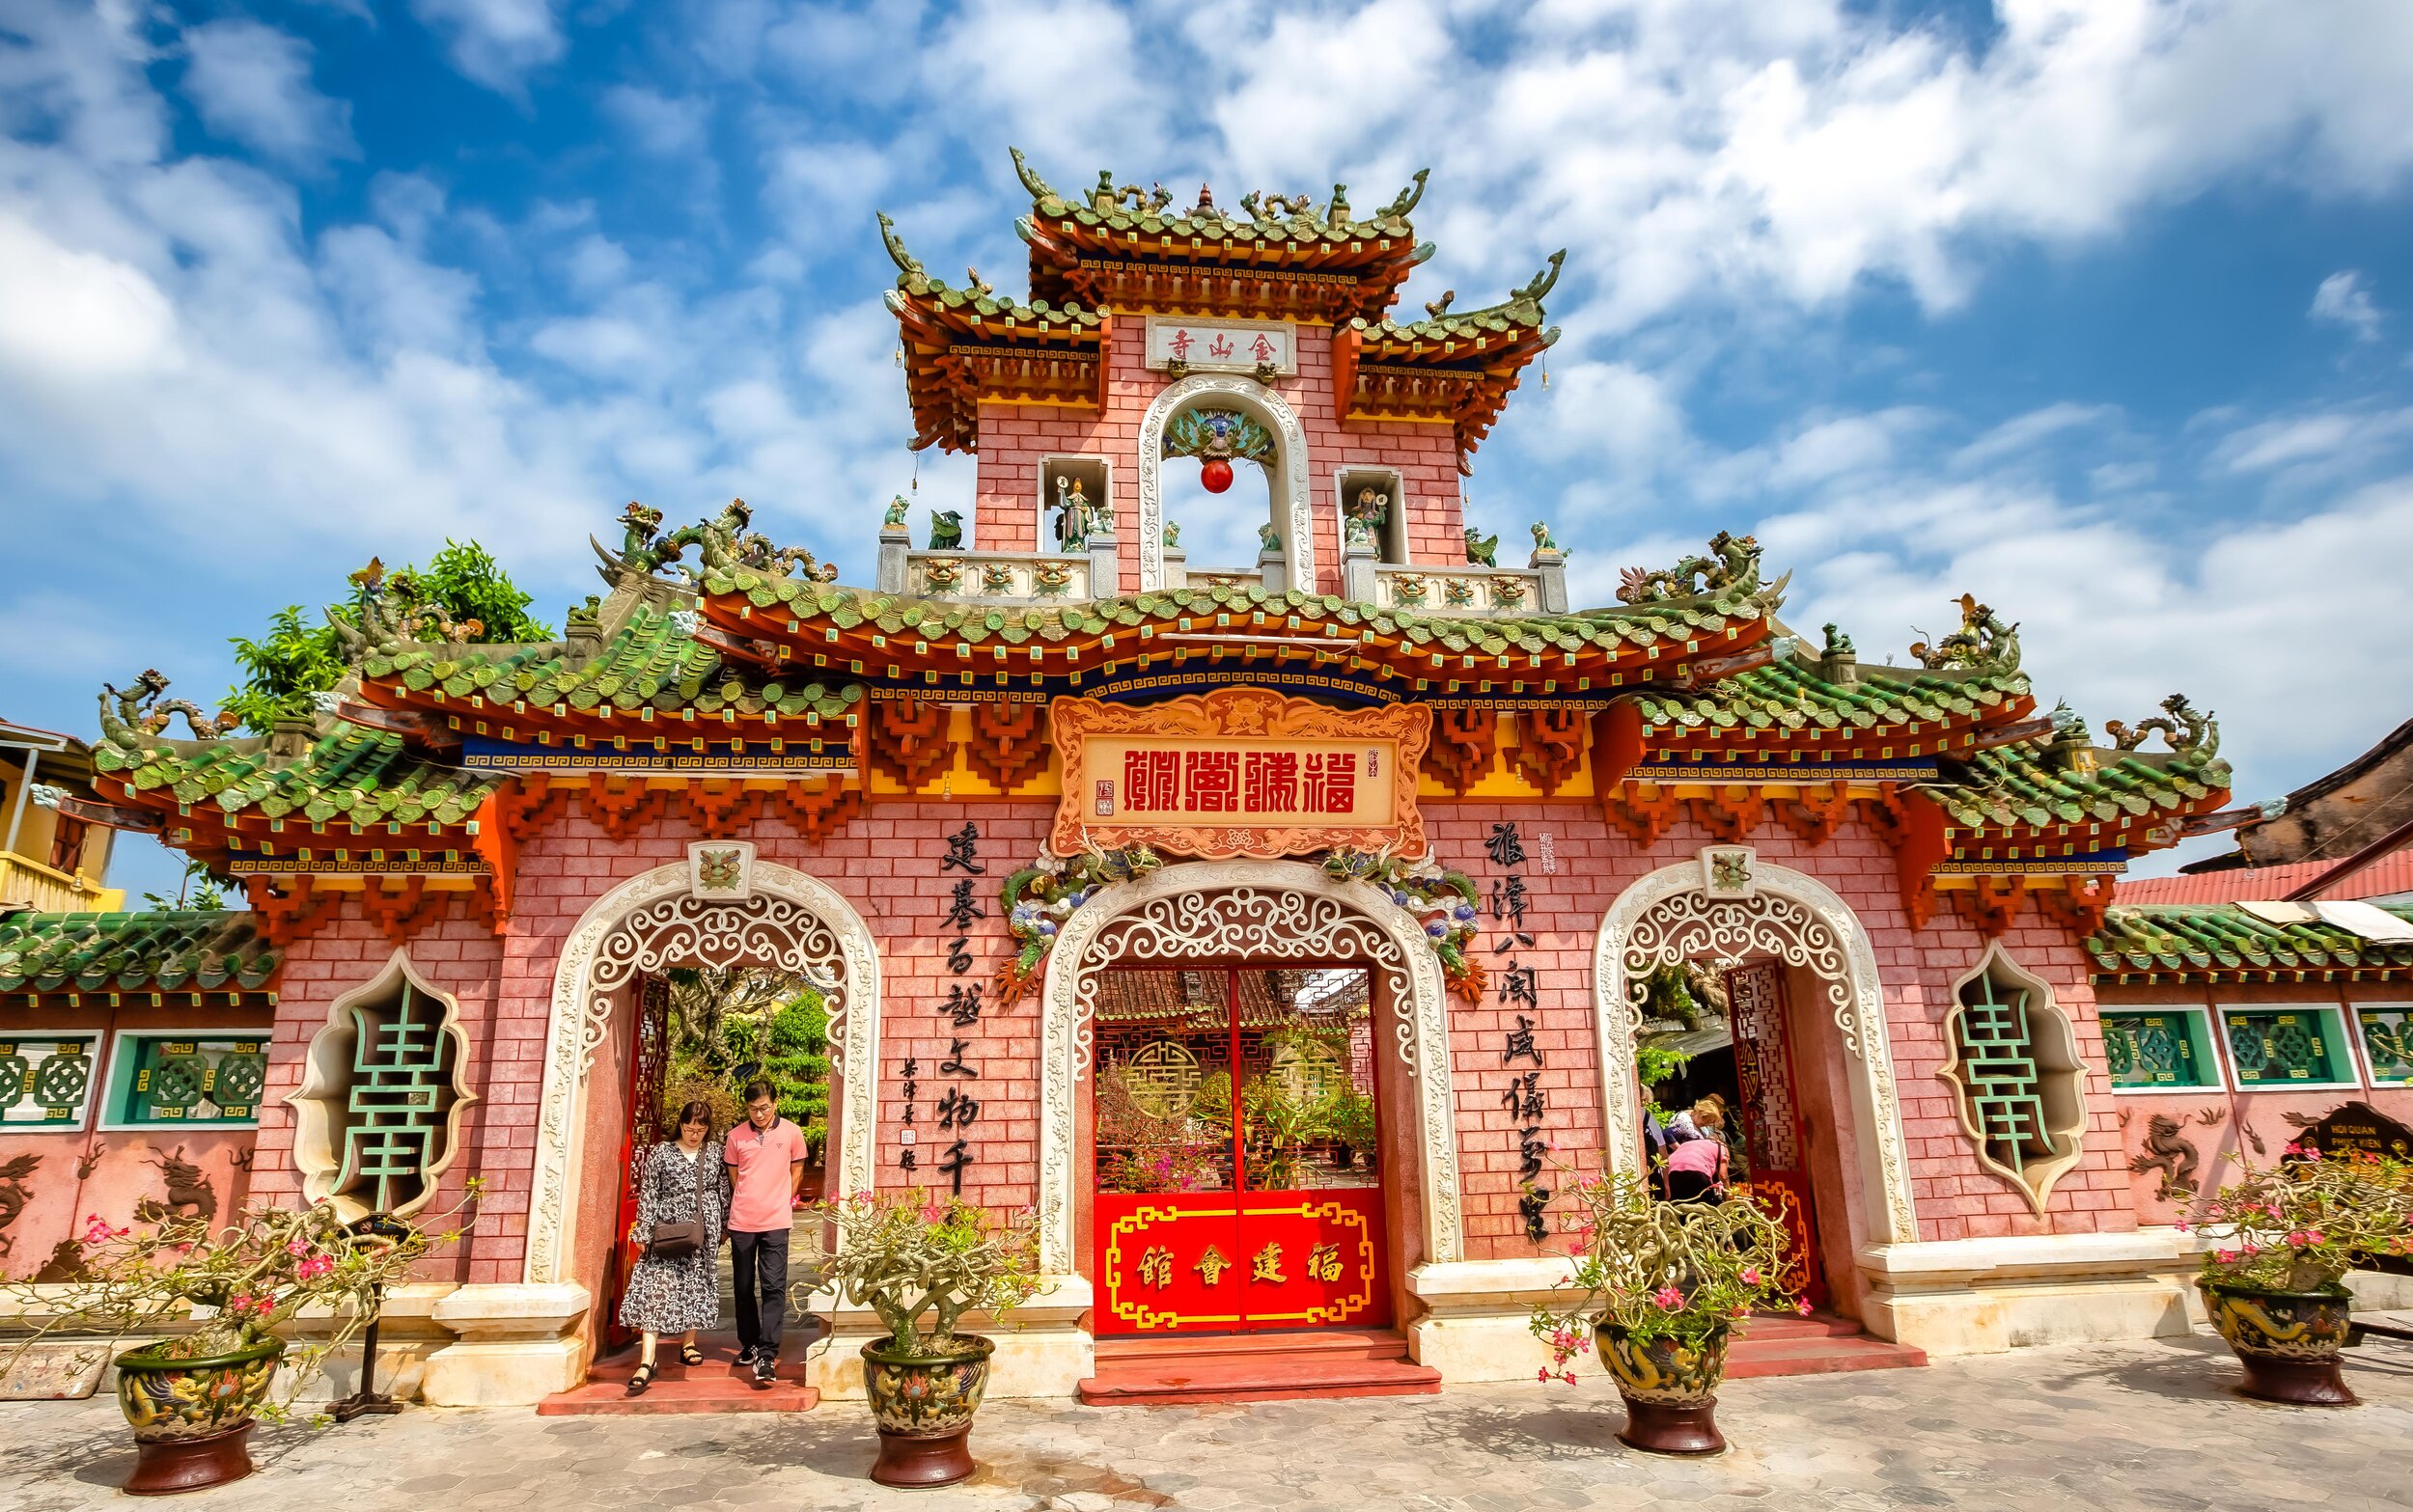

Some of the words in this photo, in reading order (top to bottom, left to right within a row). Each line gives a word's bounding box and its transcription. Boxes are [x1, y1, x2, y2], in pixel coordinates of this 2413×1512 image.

[1168, 329, 1277, 361] 金山寺
[937, 821, 986, 1226] 建基百越文物千
[1136, 1242, 1345, 1290] 福建會館
